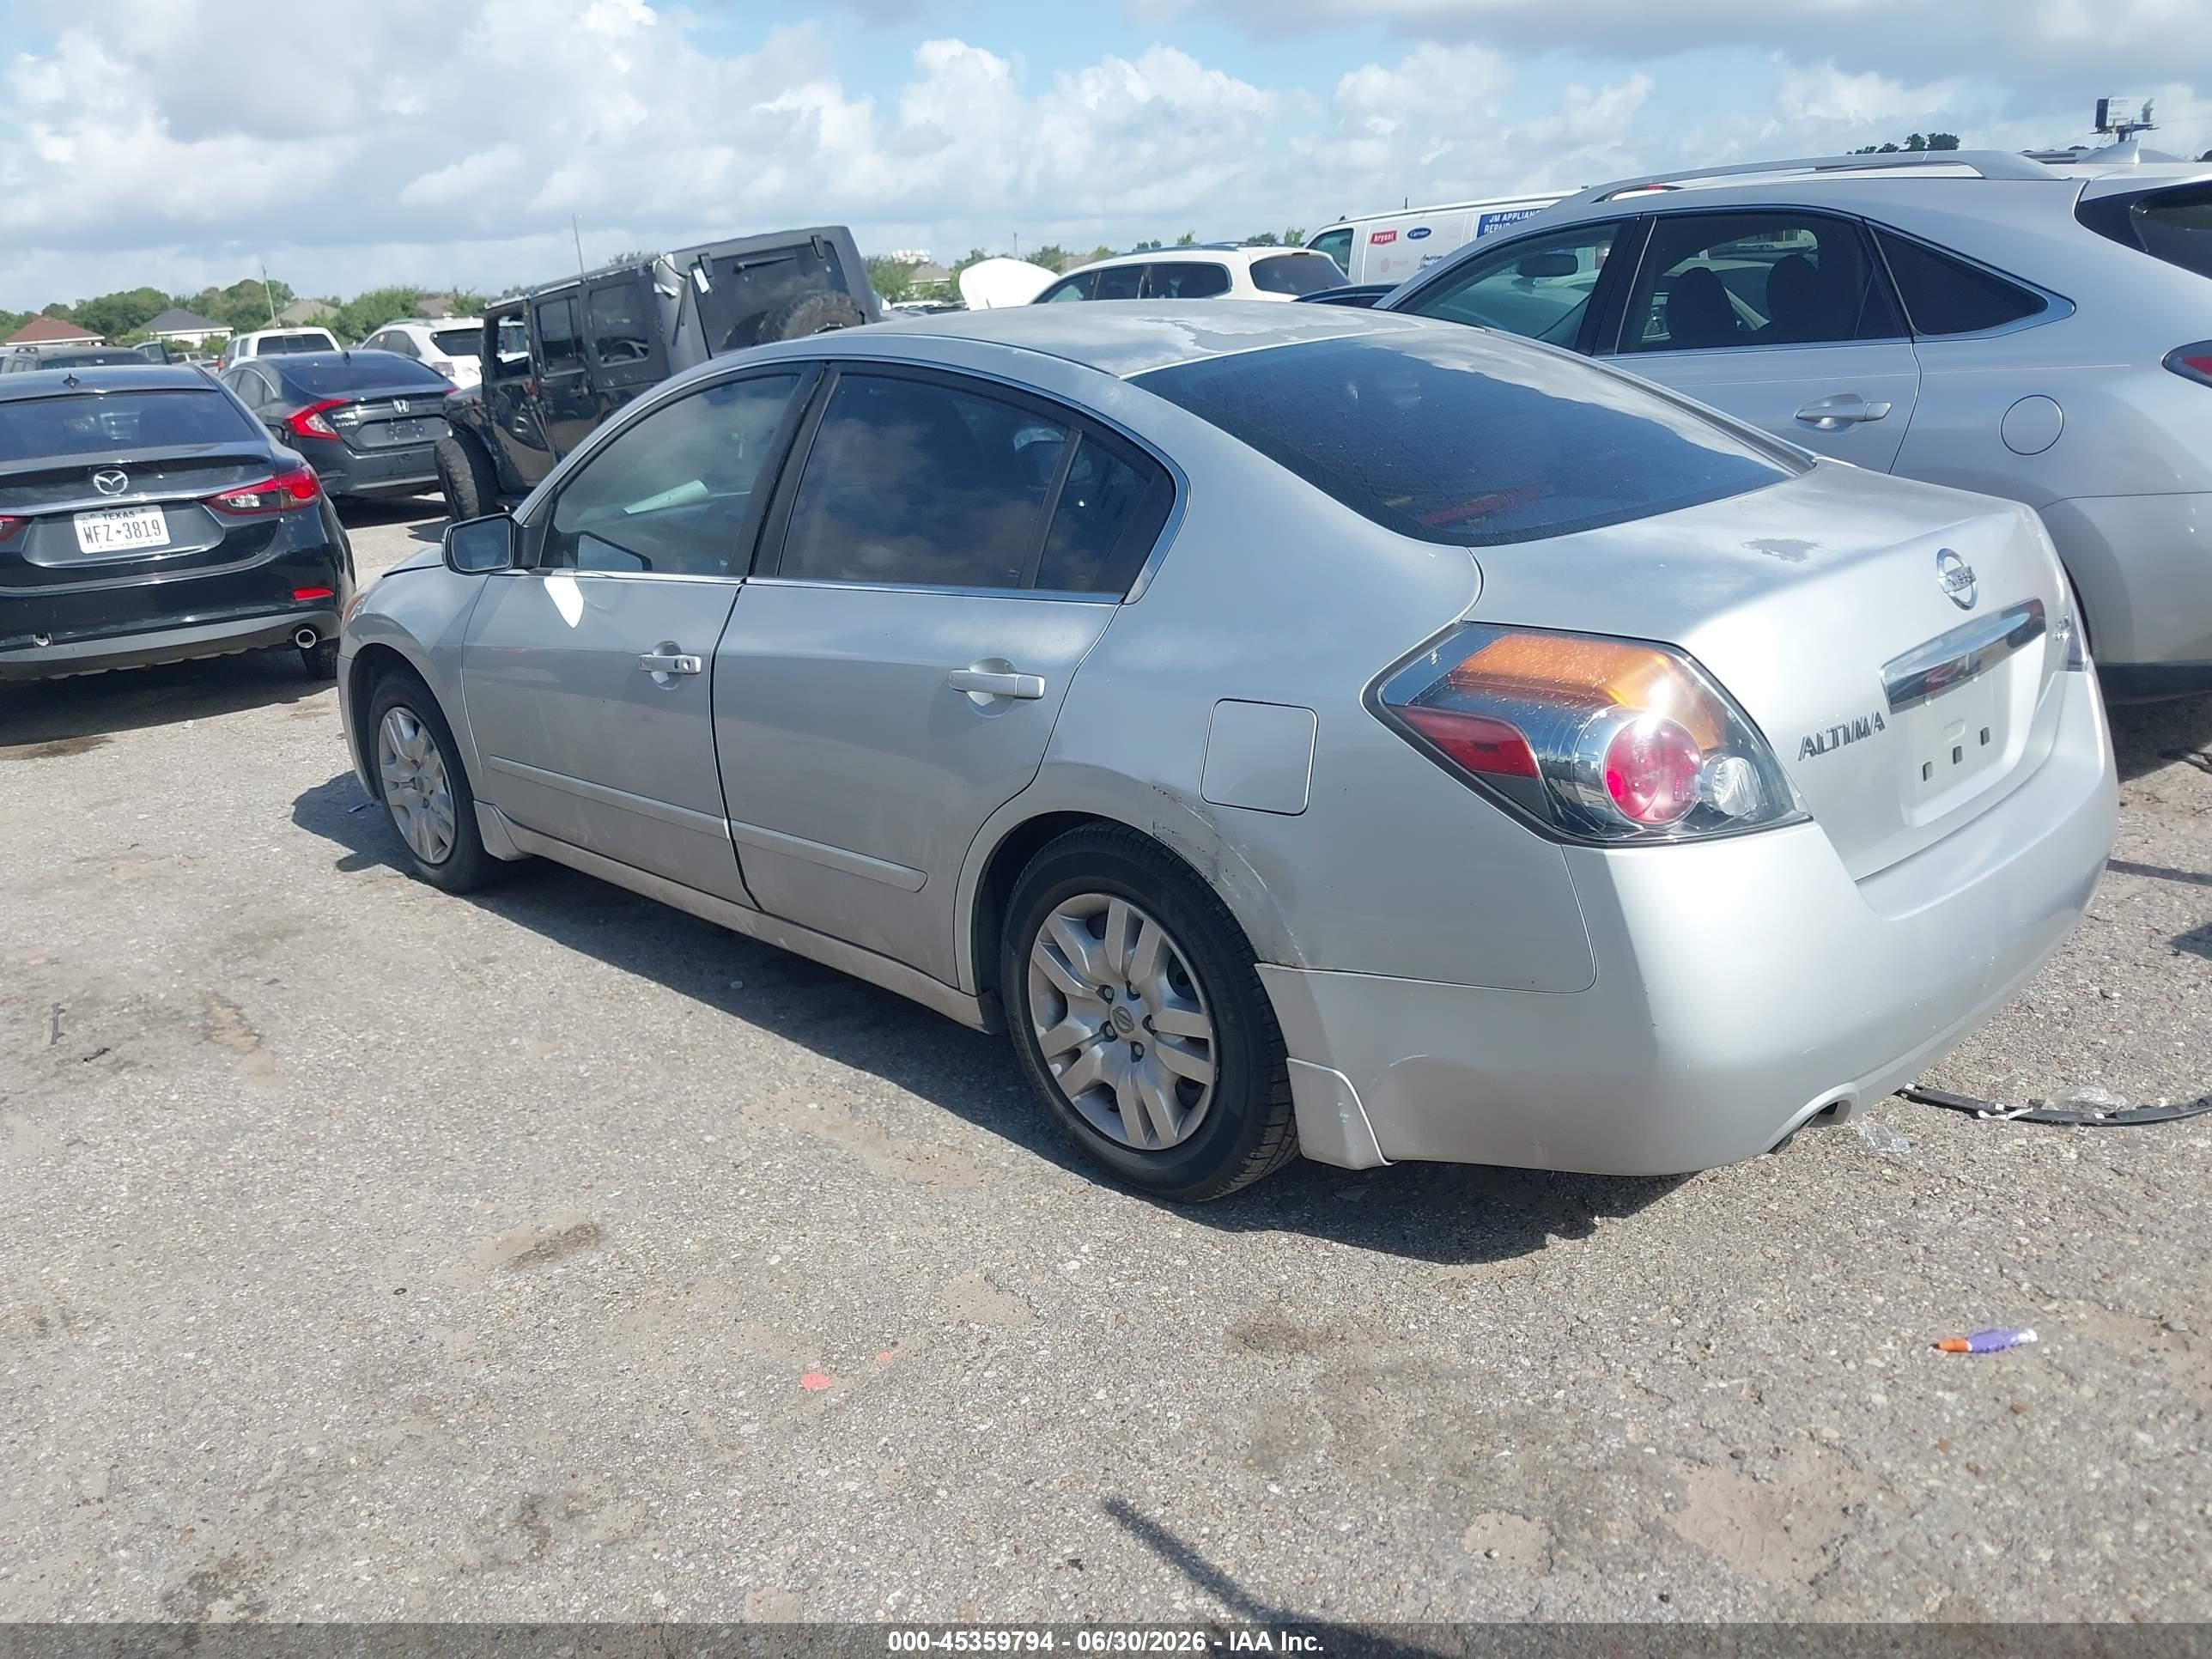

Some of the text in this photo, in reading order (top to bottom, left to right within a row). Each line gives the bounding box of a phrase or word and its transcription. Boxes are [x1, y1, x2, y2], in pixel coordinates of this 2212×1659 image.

[1489, 214, 1501, 223] JM
[1374, 232, 1395, 243] bryant
[102, 511, 136, 520] TEXAS
[122, 520, 161, 539] 3819
[1798, 711, 1886, 762] ALTIMA
